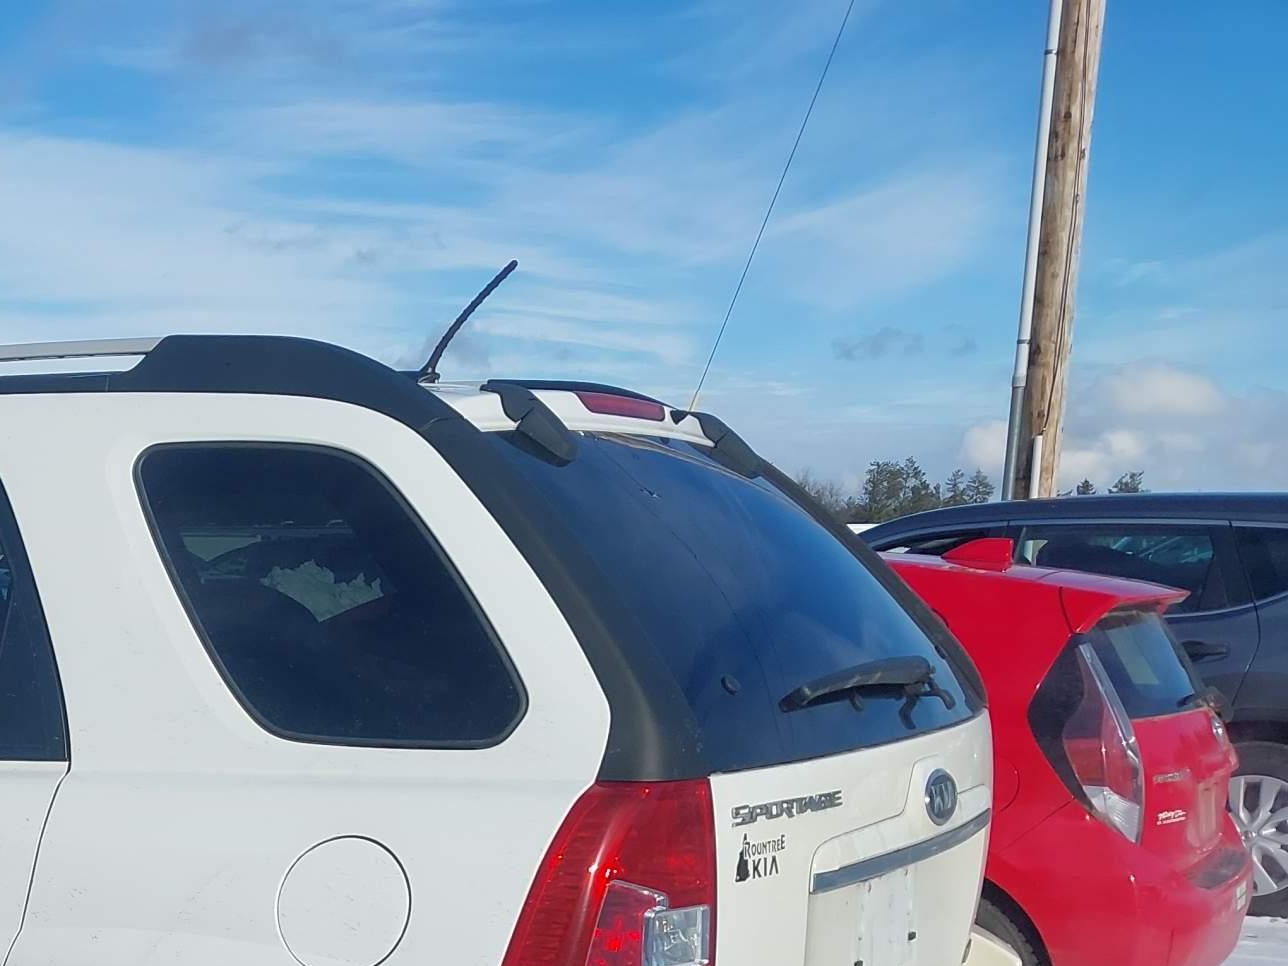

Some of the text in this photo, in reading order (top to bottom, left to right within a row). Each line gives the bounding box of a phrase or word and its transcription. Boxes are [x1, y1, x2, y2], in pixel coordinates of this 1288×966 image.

[731, 790, 843, 827] SPORTAGE
[743, 834, 785, 858] ROUNTREE
[752, 855, 779, 879] KIA
